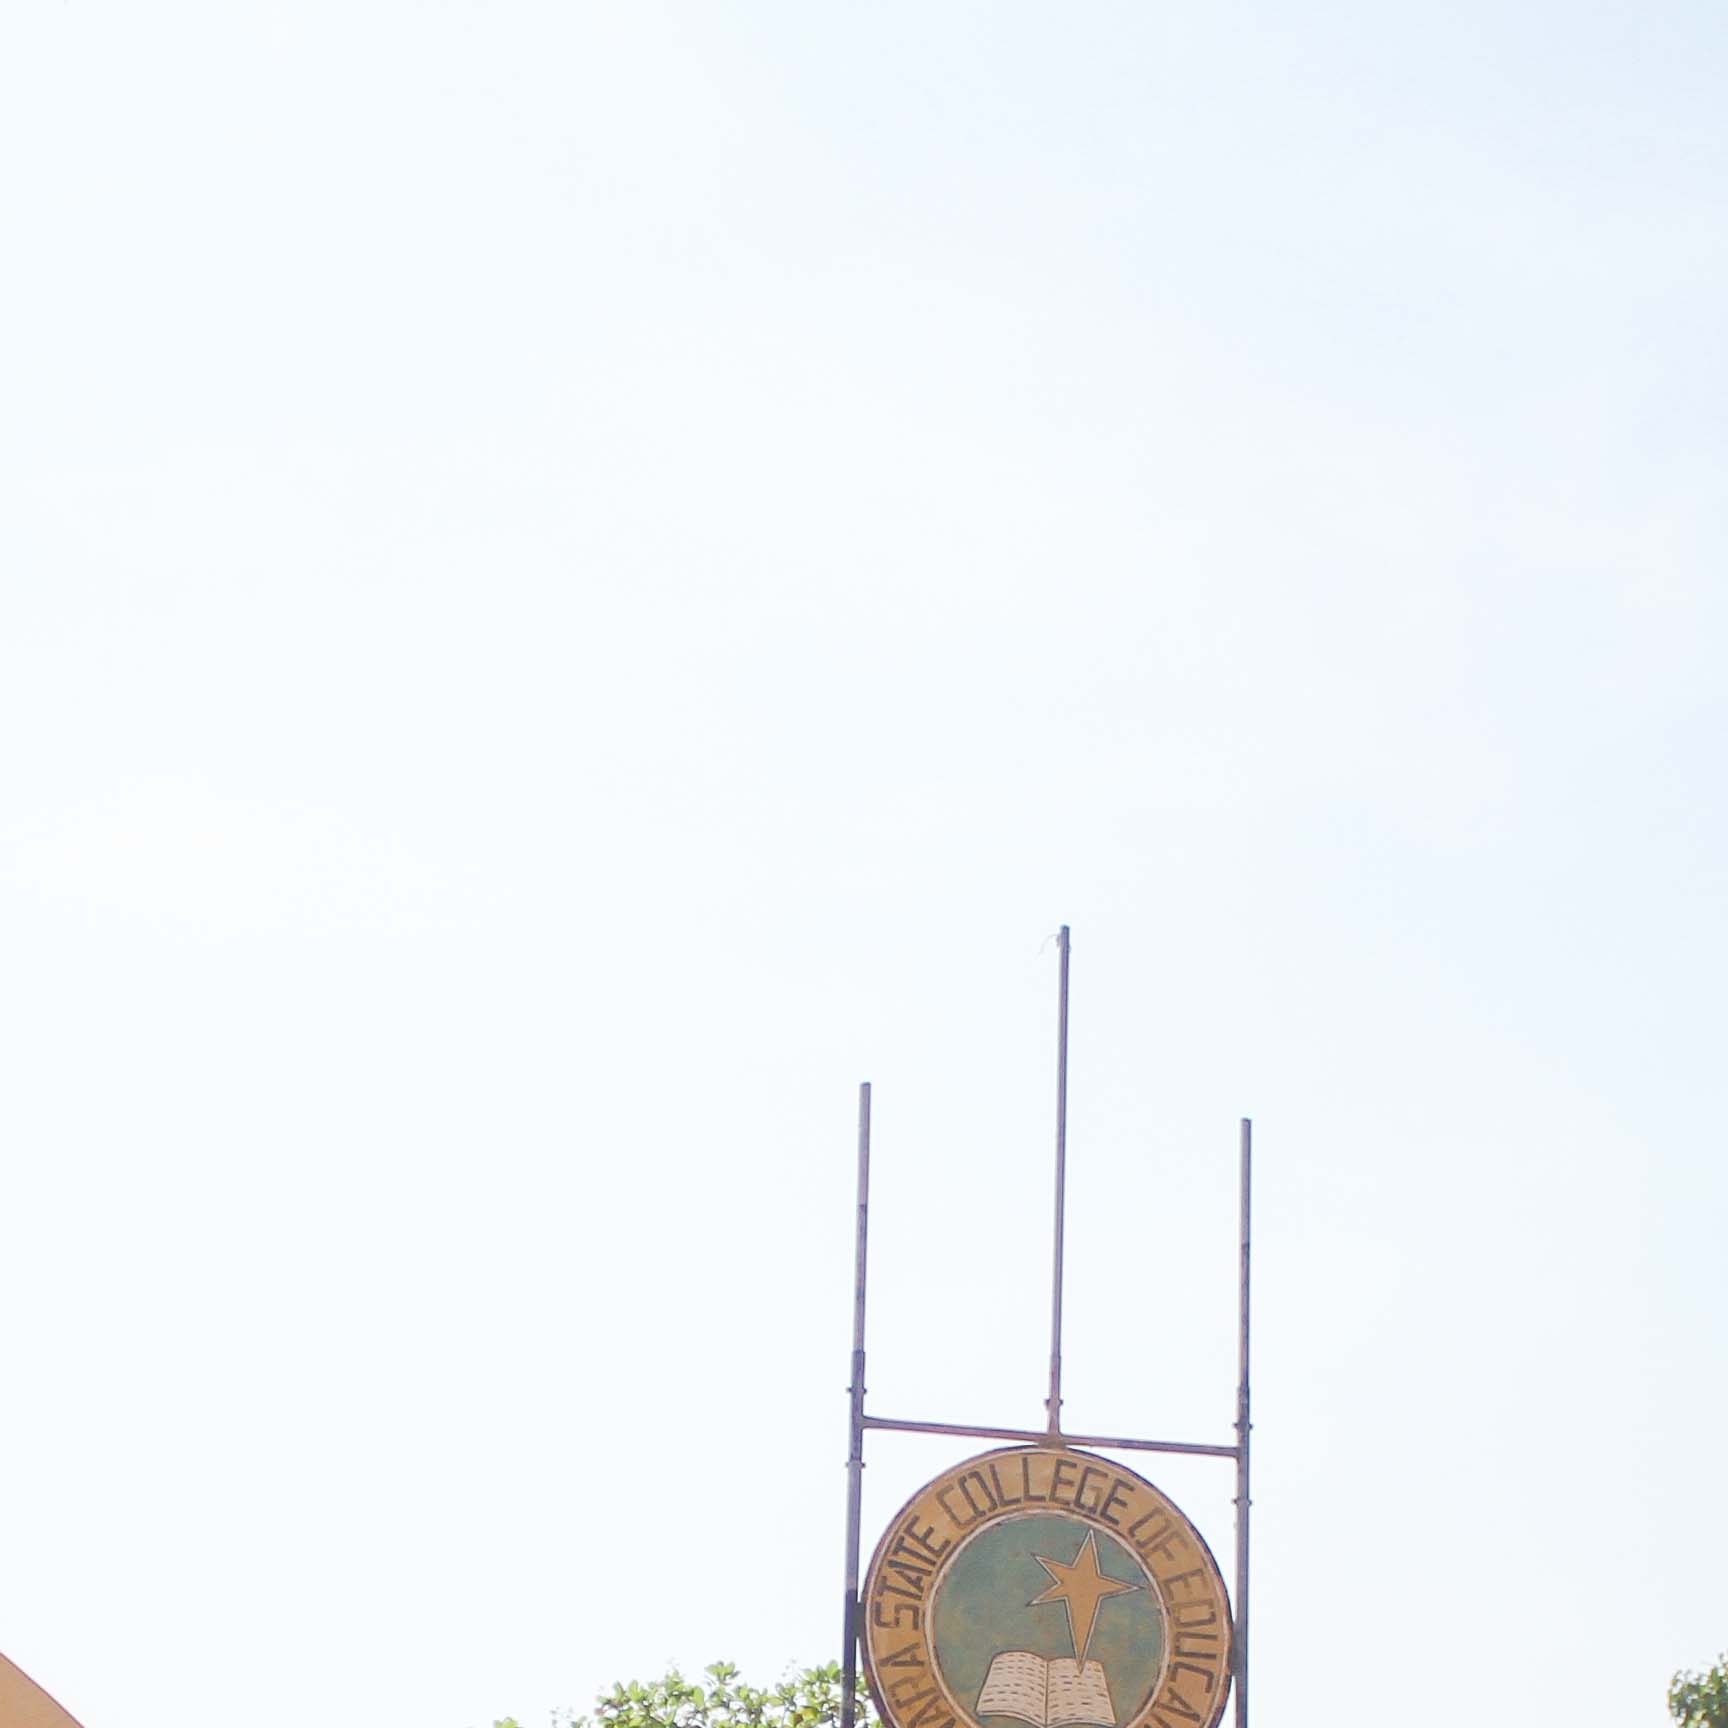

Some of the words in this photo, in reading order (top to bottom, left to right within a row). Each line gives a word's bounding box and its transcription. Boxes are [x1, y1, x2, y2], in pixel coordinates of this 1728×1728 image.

[874, 1514, 952, 1631] STATE
[935, 1456, 1136, 1529] COLLEGE
[1128, 1506, 1189, 1560] OF
